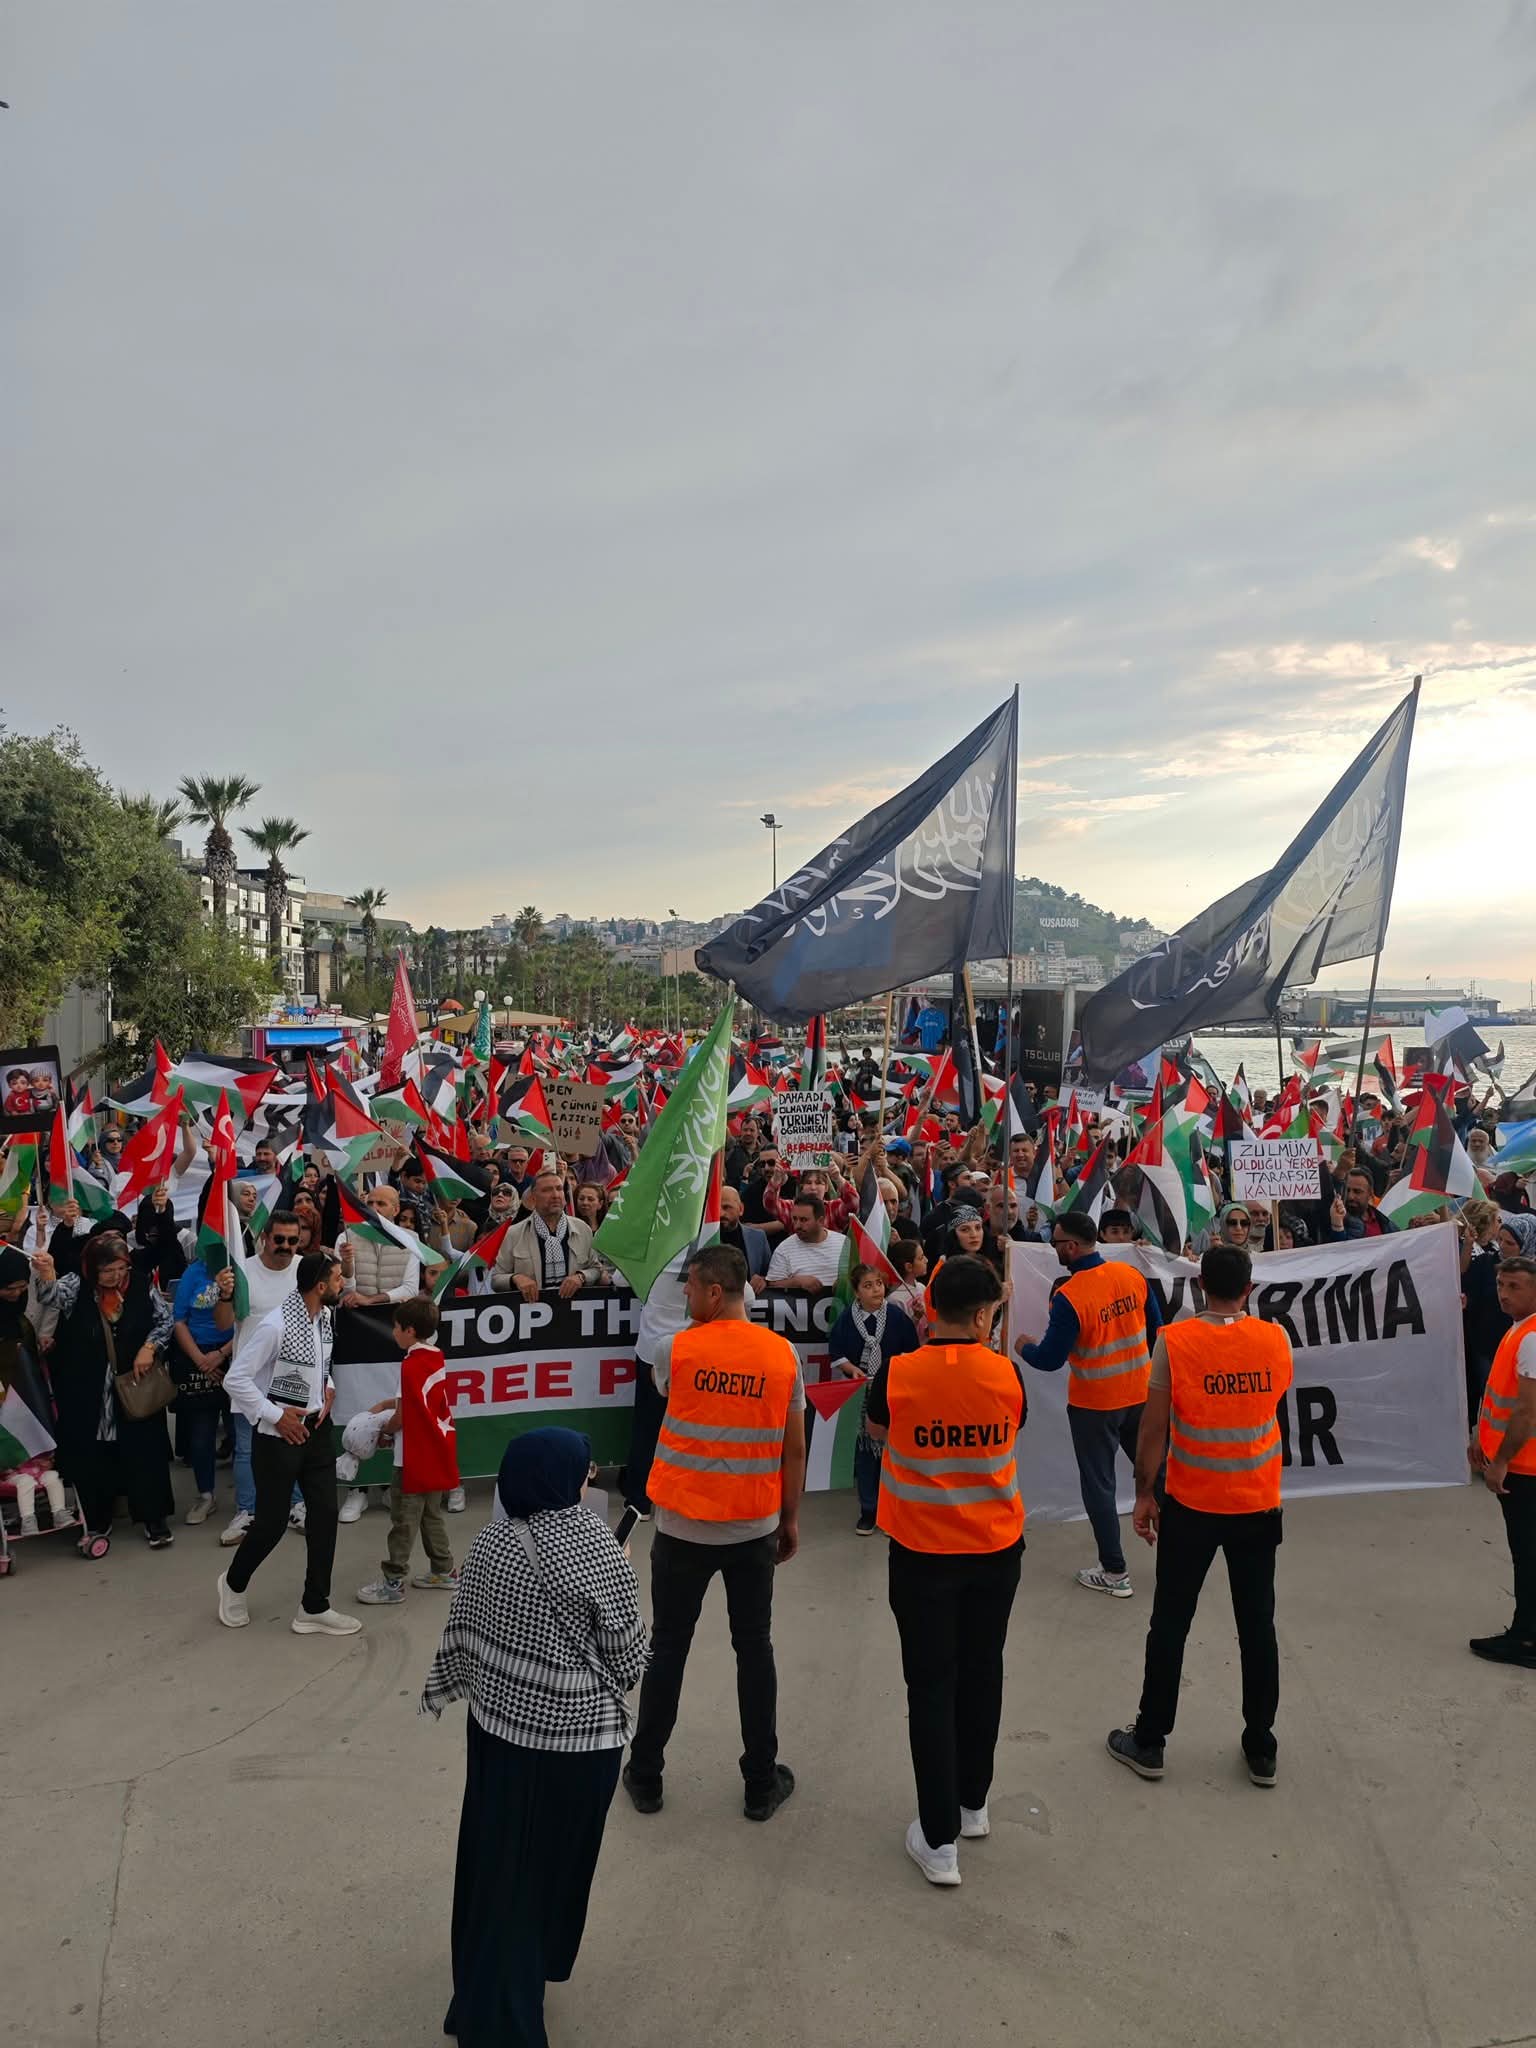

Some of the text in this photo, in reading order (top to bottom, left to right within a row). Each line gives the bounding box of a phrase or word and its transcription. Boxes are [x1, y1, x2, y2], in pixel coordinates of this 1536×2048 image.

[1240, 1140, 1312, 1158] ZULMÜN
[1233, 1156, 1319, 1171] OLDUĞU YERDE
[1245, 1169, 1319, 1184] TARAFSIZ
[1244, 1183, 1321, 1200] KALINMAZ
[571, 1298, 641, 1336] TH
[446, 1360, 573, 1407] REE
[694, 1366, 767, 1399] GÖREVLİ
[1203, 1367, 1273, 1395] GÖREVLİ
[914, 1415, 1010, 1449] GÖREVLİ
